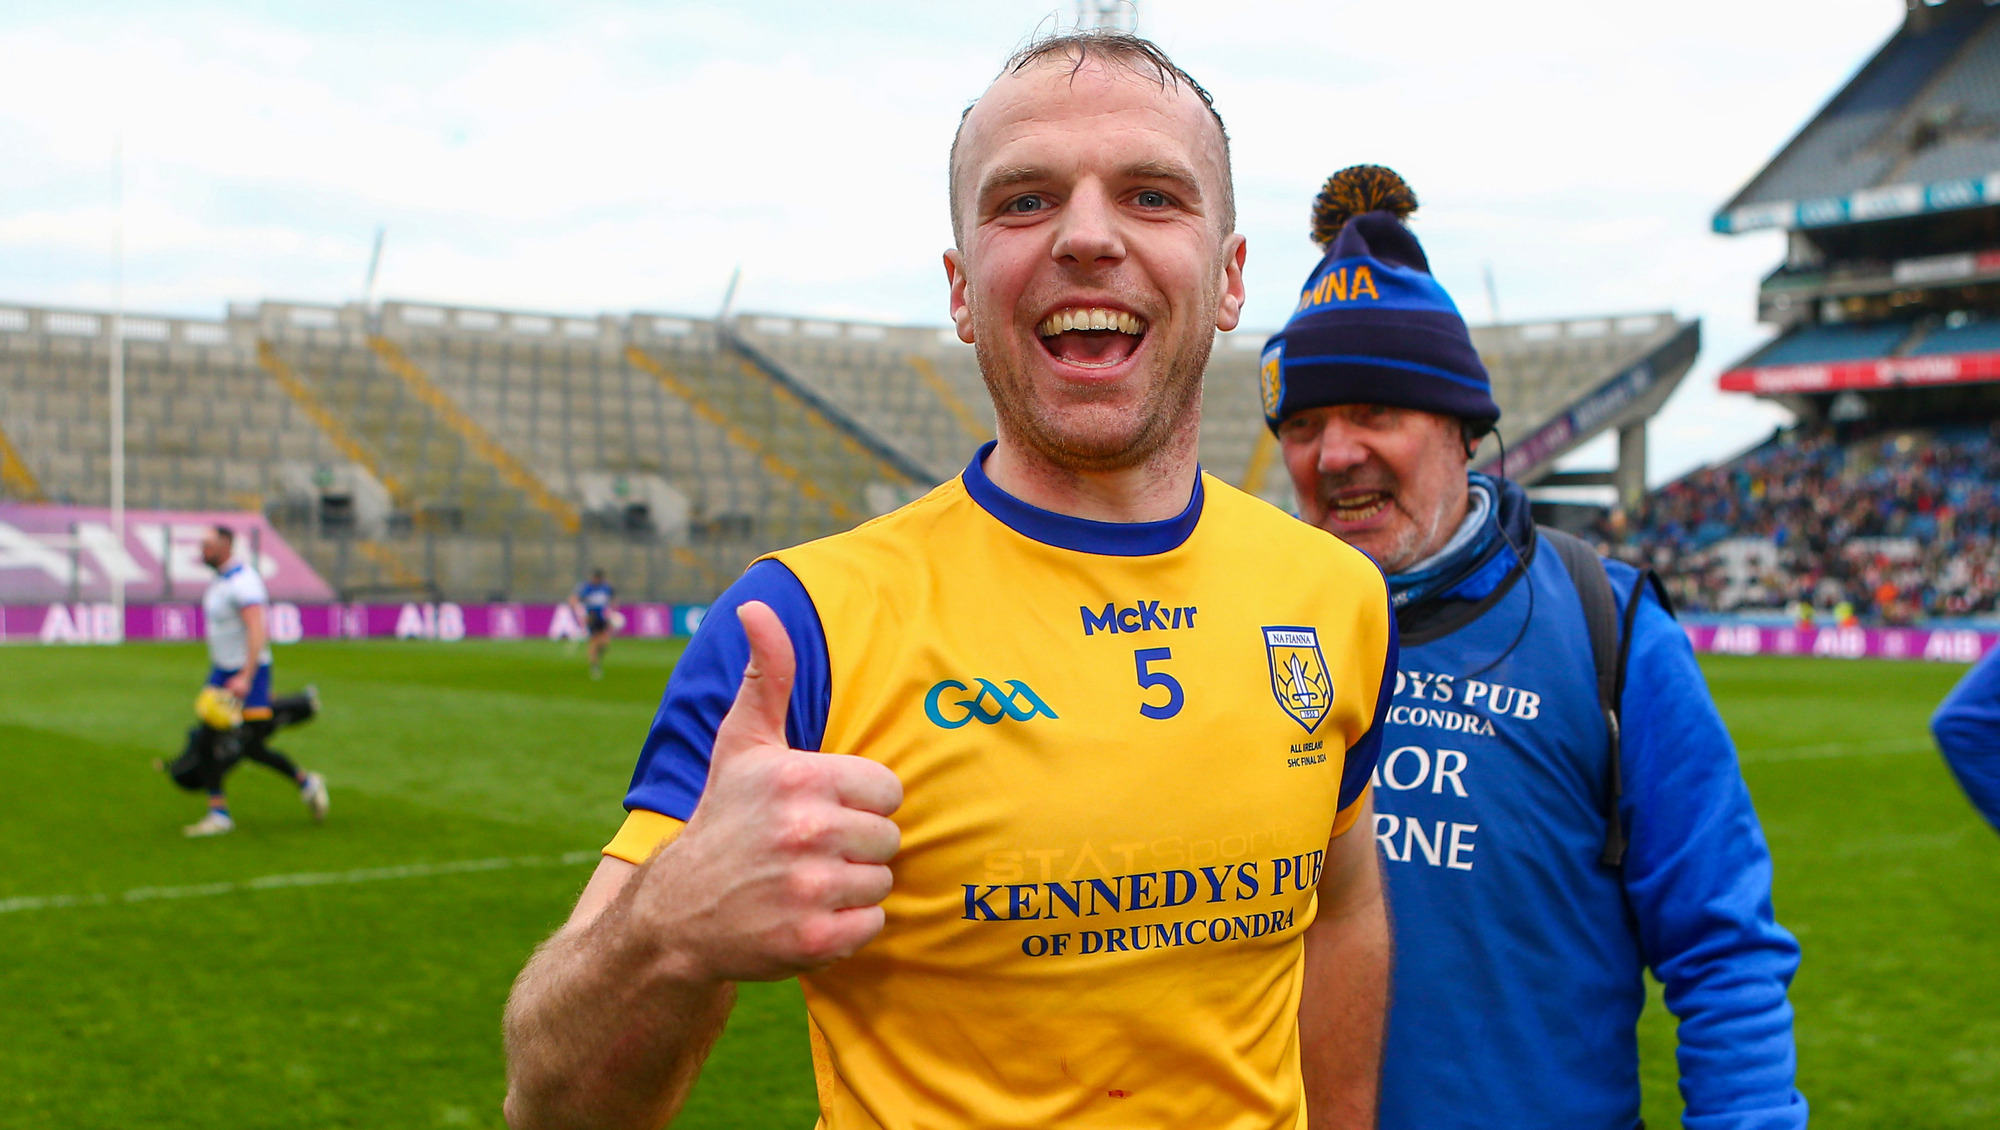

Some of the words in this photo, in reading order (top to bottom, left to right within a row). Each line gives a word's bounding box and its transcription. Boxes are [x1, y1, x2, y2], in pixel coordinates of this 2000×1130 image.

[396, 602, 466, 641] AIB
[1272, 633, 1285, 643] NA
[1285, 634, 1312, 645] FIANNA
[1134, 647, 1184, 720] 5
[1463, 679, 1541, 720] PUB
[1287, 758, 1300, 768] SHC
[1301, 756, 1316, 765] FINAL
[1291, 744, 1302, 753] ALL
[1374, 813, 1479, 871] RNE
[961, 861, 1260, 921] KENNEDYS
[1270, 849, 1324, 896] PUB
[1021, 933, 1071, 957] OF
[1079, 907, 1295, 955] DRUMCONDRA
